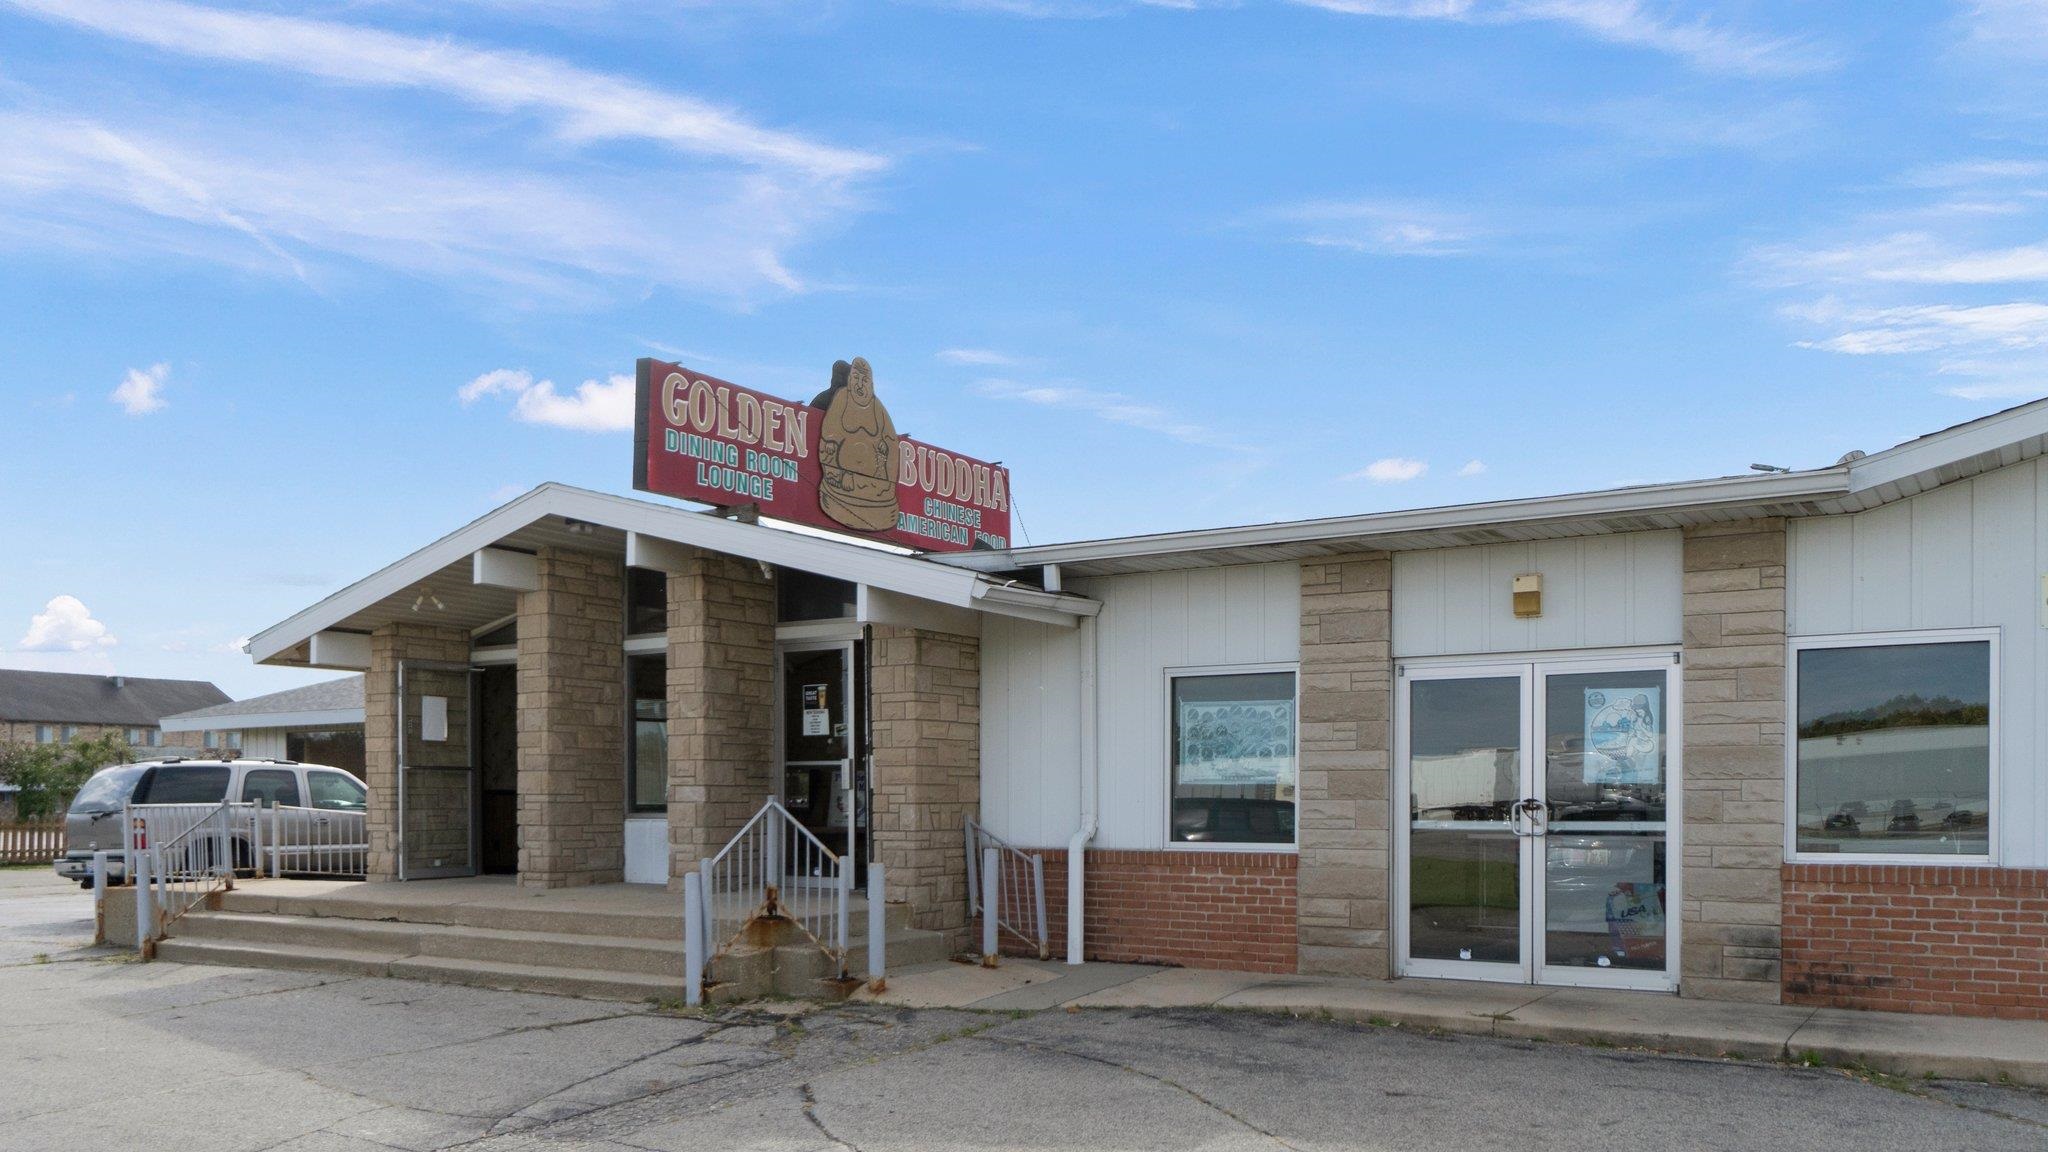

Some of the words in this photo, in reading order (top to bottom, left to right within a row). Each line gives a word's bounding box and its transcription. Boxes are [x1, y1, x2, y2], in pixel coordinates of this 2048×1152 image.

[662, 372, 809, 458] GOLDEN
[899, 440, 1008, 512] BUDDHA
[665, 427, 739, 467] DINING
[746, 448, 798, 482] ROOM
[697, 462, 774, 501] LOUNGE
[897, 511, 969, 546] AMERICAN
[924, 496, 981, 529] CHINESE
